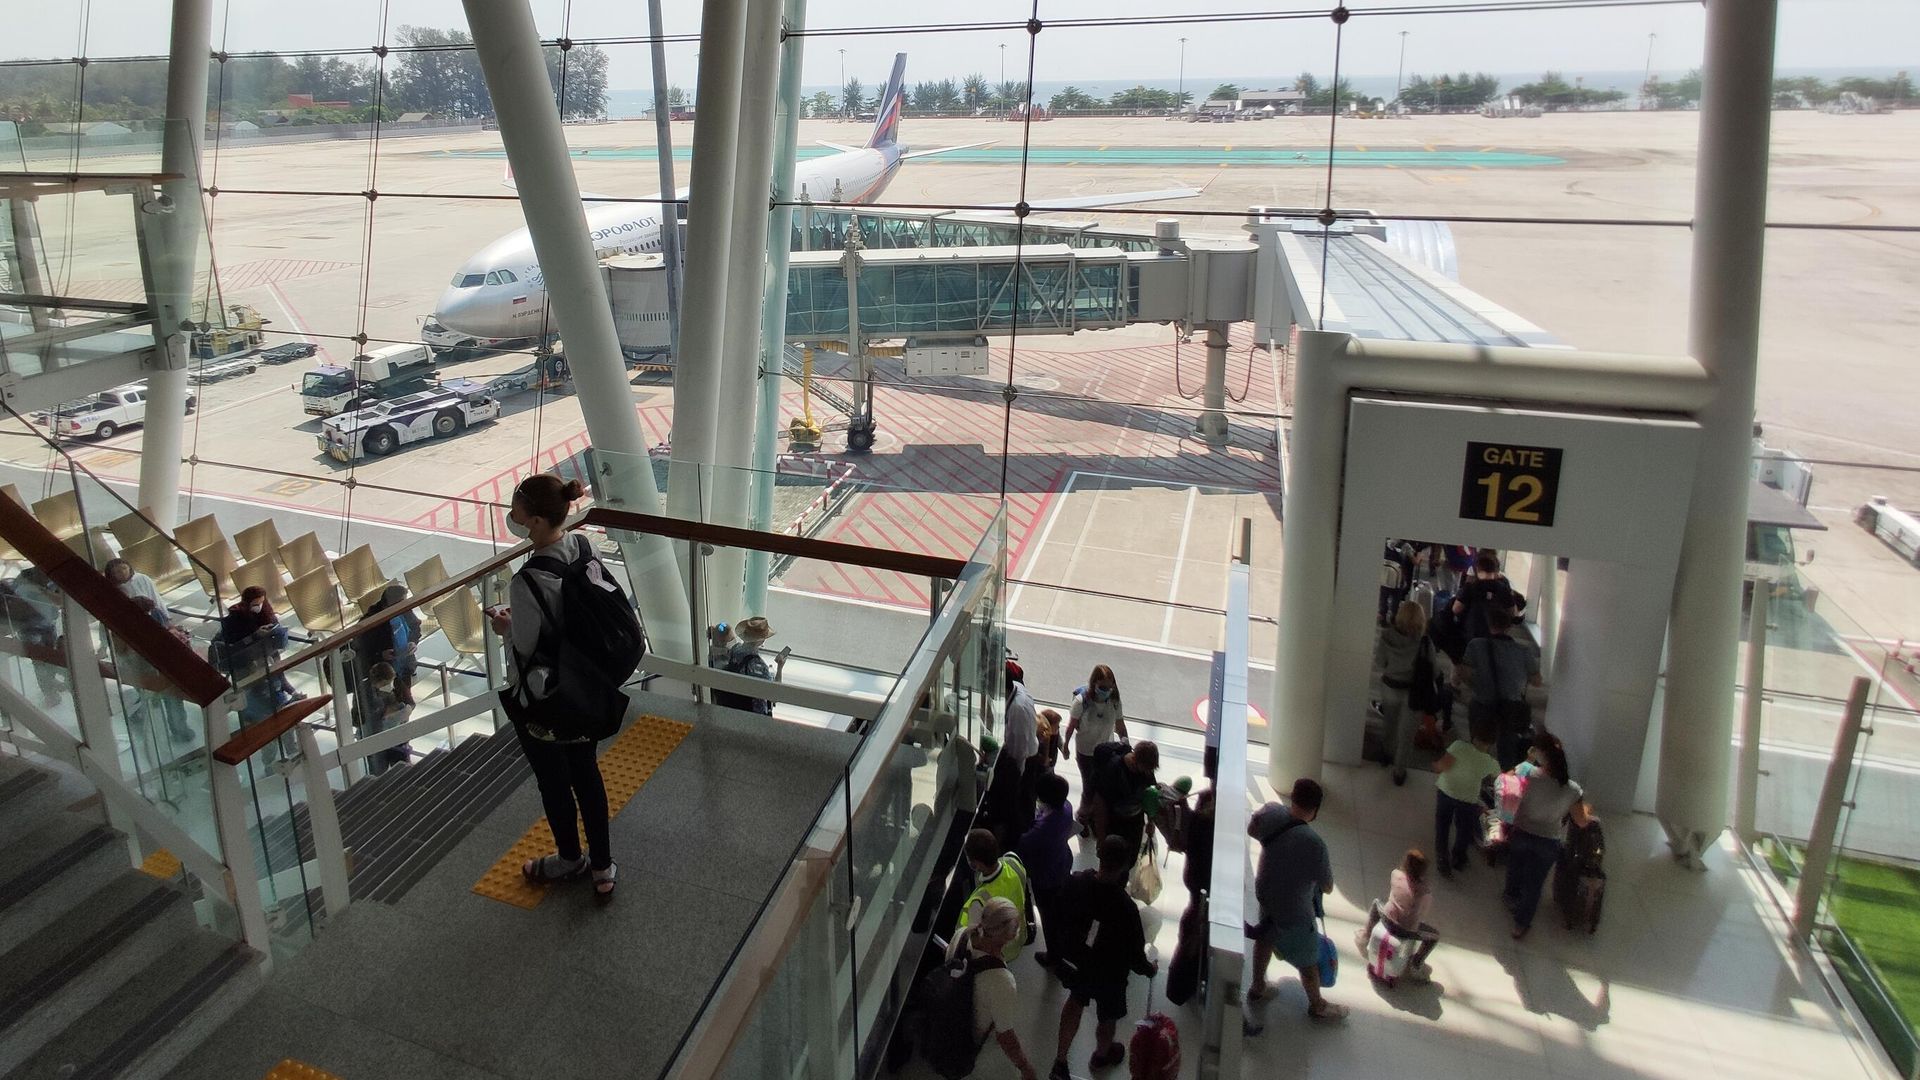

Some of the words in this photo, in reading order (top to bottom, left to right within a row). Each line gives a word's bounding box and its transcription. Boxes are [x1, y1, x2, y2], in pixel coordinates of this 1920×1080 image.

[590, 216, 656, 241] ЭРОФЛОТ
[1483, 447, 1544, 468] GATE
[1477, 471, 1543, 521] 12
